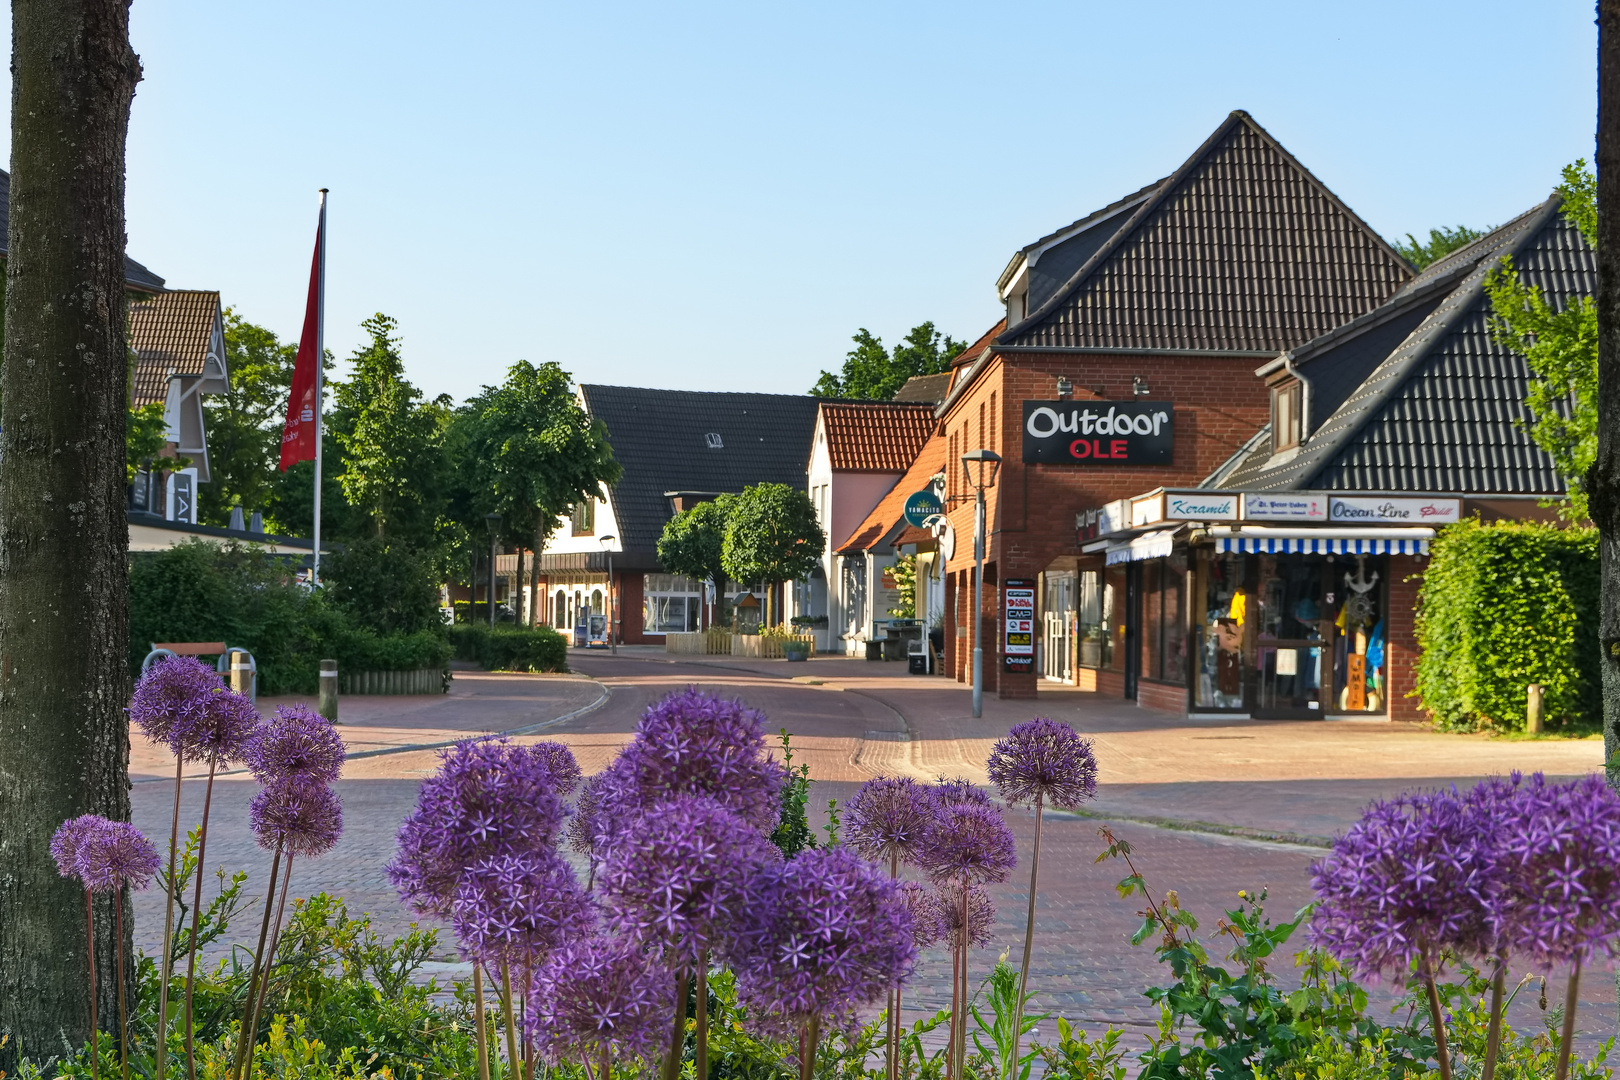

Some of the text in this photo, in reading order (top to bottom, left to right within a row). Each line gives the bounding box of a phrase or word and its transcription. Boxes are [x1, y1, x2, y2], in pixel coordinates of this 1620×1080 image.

[1027, 406, 1169, 438] Outdoor
[1069, 439, 1128, 459] OLE
[1172, 500, 1231, 515] Keramik
[1333, 501, 1375, 518] Ocean
[1377, 502, 1410, 519] Line
[1008, 610, 1032, 618] CMP
[1006, 657, 1032, 665] Outdoor
